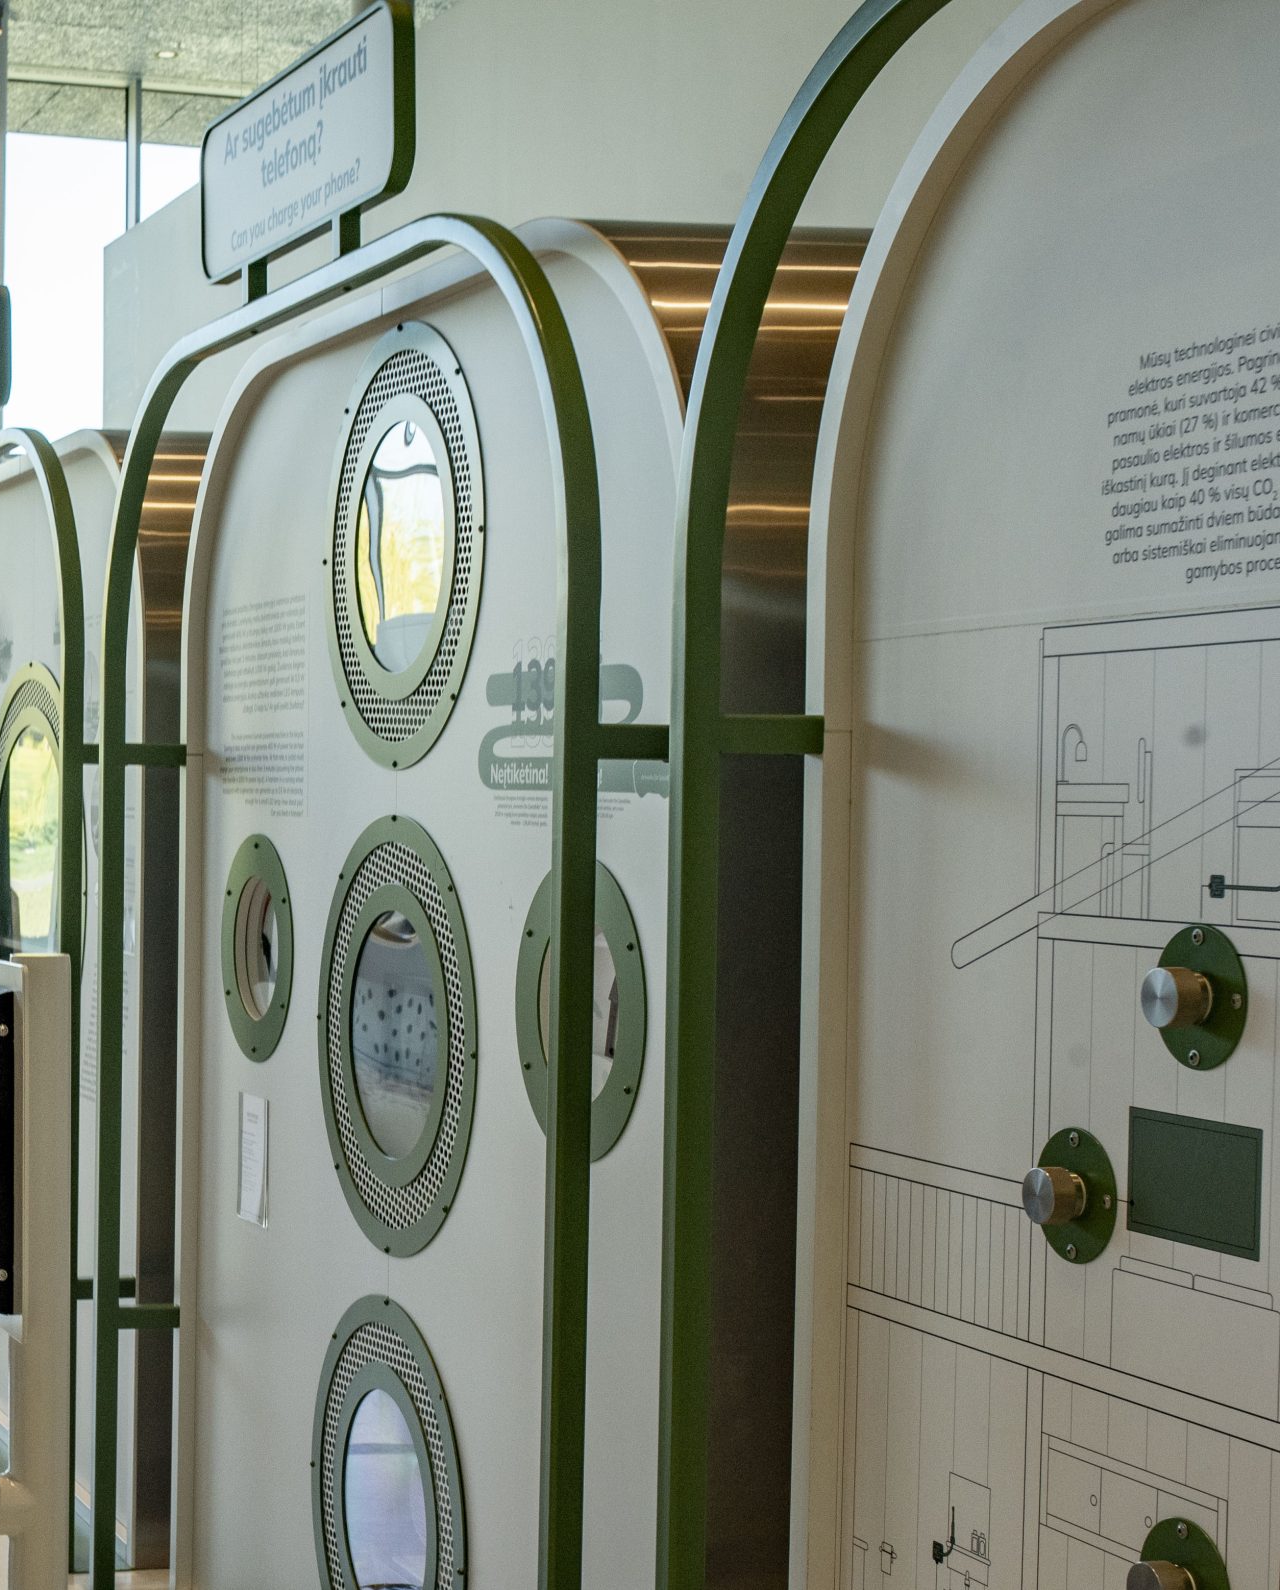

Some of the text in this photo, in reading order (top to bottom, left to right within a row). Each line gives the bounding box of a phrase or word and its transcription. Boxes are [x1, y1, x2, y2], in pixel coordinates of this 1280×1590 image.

[224, 35, 367, 165] Ar sugebėtum įkrauti
[260, 119, 324, 188] telefoną?
[230, 158, 361, 251] Can you charge your phone?
[1140, 352, 1171, 370] Mūsų
[1174, 328, 1256, 362] technologinei
[1128, 375, 1173, 397] elektros
[1176, 362, 1234, 386] energijos.
[1107, 400, 1161, 428] pramonė,
[1164, 394, 1186, 412] kuri
[1188, 382, 1247, 408] suvartoja
[1250, 377, 1267, 394] 42
[1112, 430, 1146, 447] namų
[1148, 419, 1176, 440] ūkiai
[1179, 415, 1199, 438] (27
[1201, 412, 1219, 432] %)
[1222, 409, 1232, 426] ir
[1111, 447, 1161, 475] pasaulio
[1163, 442, 1210, 462] elektros
[1212, 437, 1222, 453] ir
[1224, 429, 1273, 451] šilumos
[1101, 474, 1148, 497] iškastinį
[1150, 472, 1178, 490] kurą.
[1192, 458, 1248, 483] deginant
[1111, 498, 1158, 519] daugiau
[1161, 493, 1186, 511] kaip
[1189, 488, 1205, 505] 40
[1208, 487, 1221, 503] %
[1224, 483, 1249, 502] visų
[1105, 524, 1143, 546] galima
[1146, 513, 1204, 537] sumažinti
[1206, 510, 1245, 528] dviem
[1112, 547, 1139, 564] arba
[1141, 538, 1207, 561] sistemiškai
[1185, 560, 1243, 584] gamybos
[490, 762, 549, 789] Neįtikėtina!
